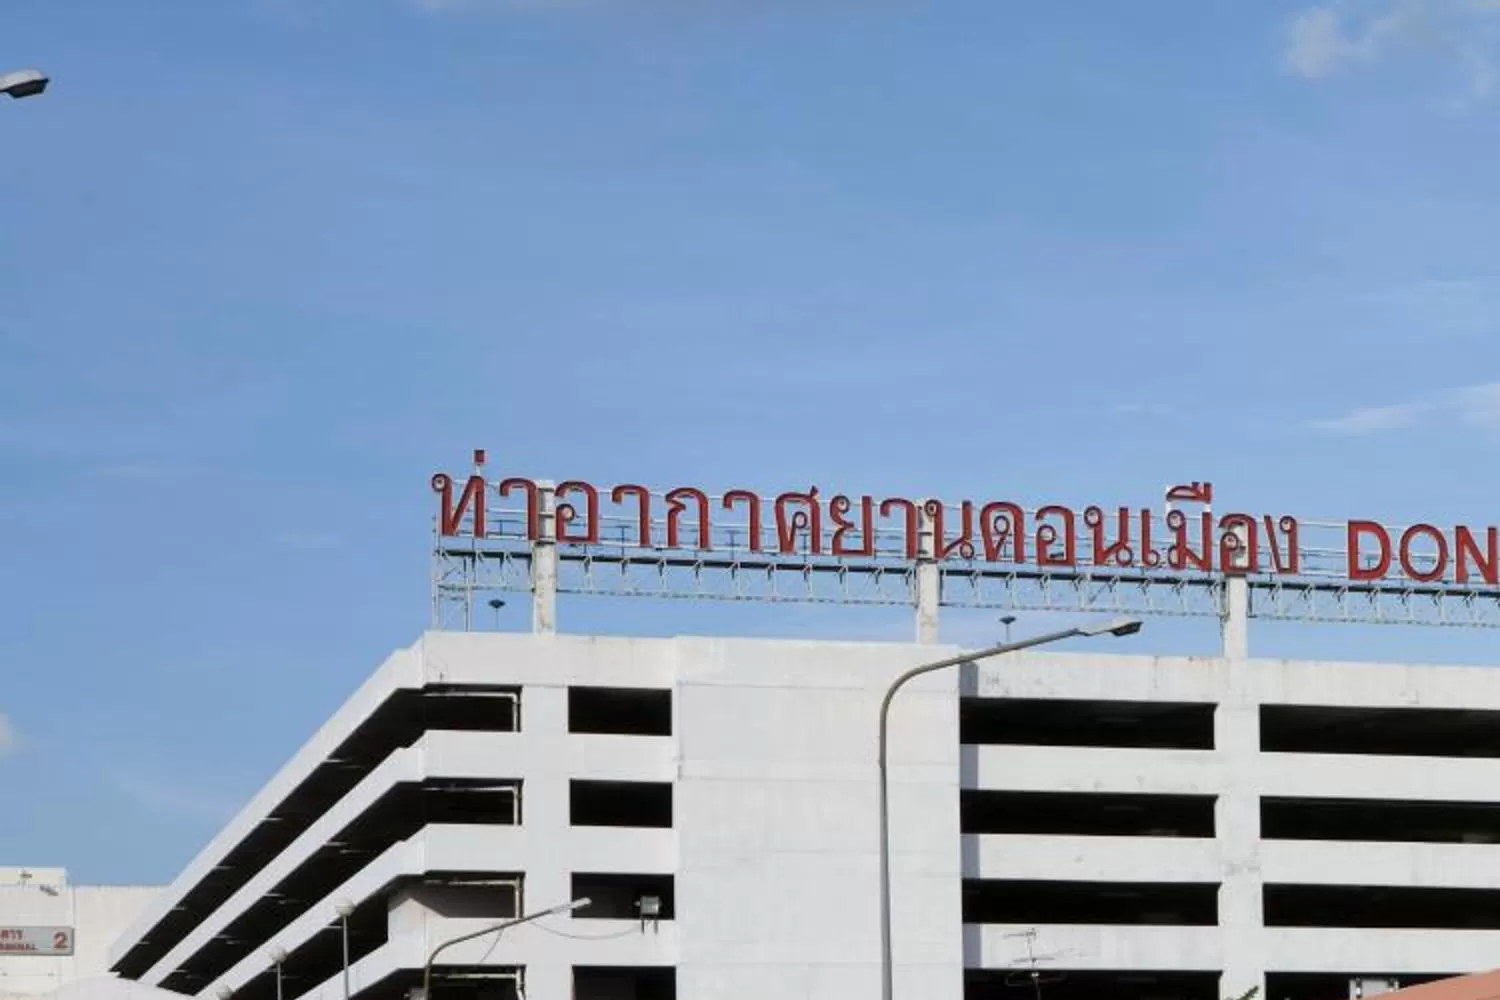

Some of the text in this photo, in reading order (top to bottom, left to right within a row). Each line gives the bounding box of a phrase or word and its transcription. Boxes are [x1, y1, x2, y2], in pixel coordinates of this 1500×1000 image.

[430, 449, 1299, 574] ท่าอากาศยานดอนเมือง
[1346, 519, 1499, 586] DON
[53, 931, 69, 949] 2
